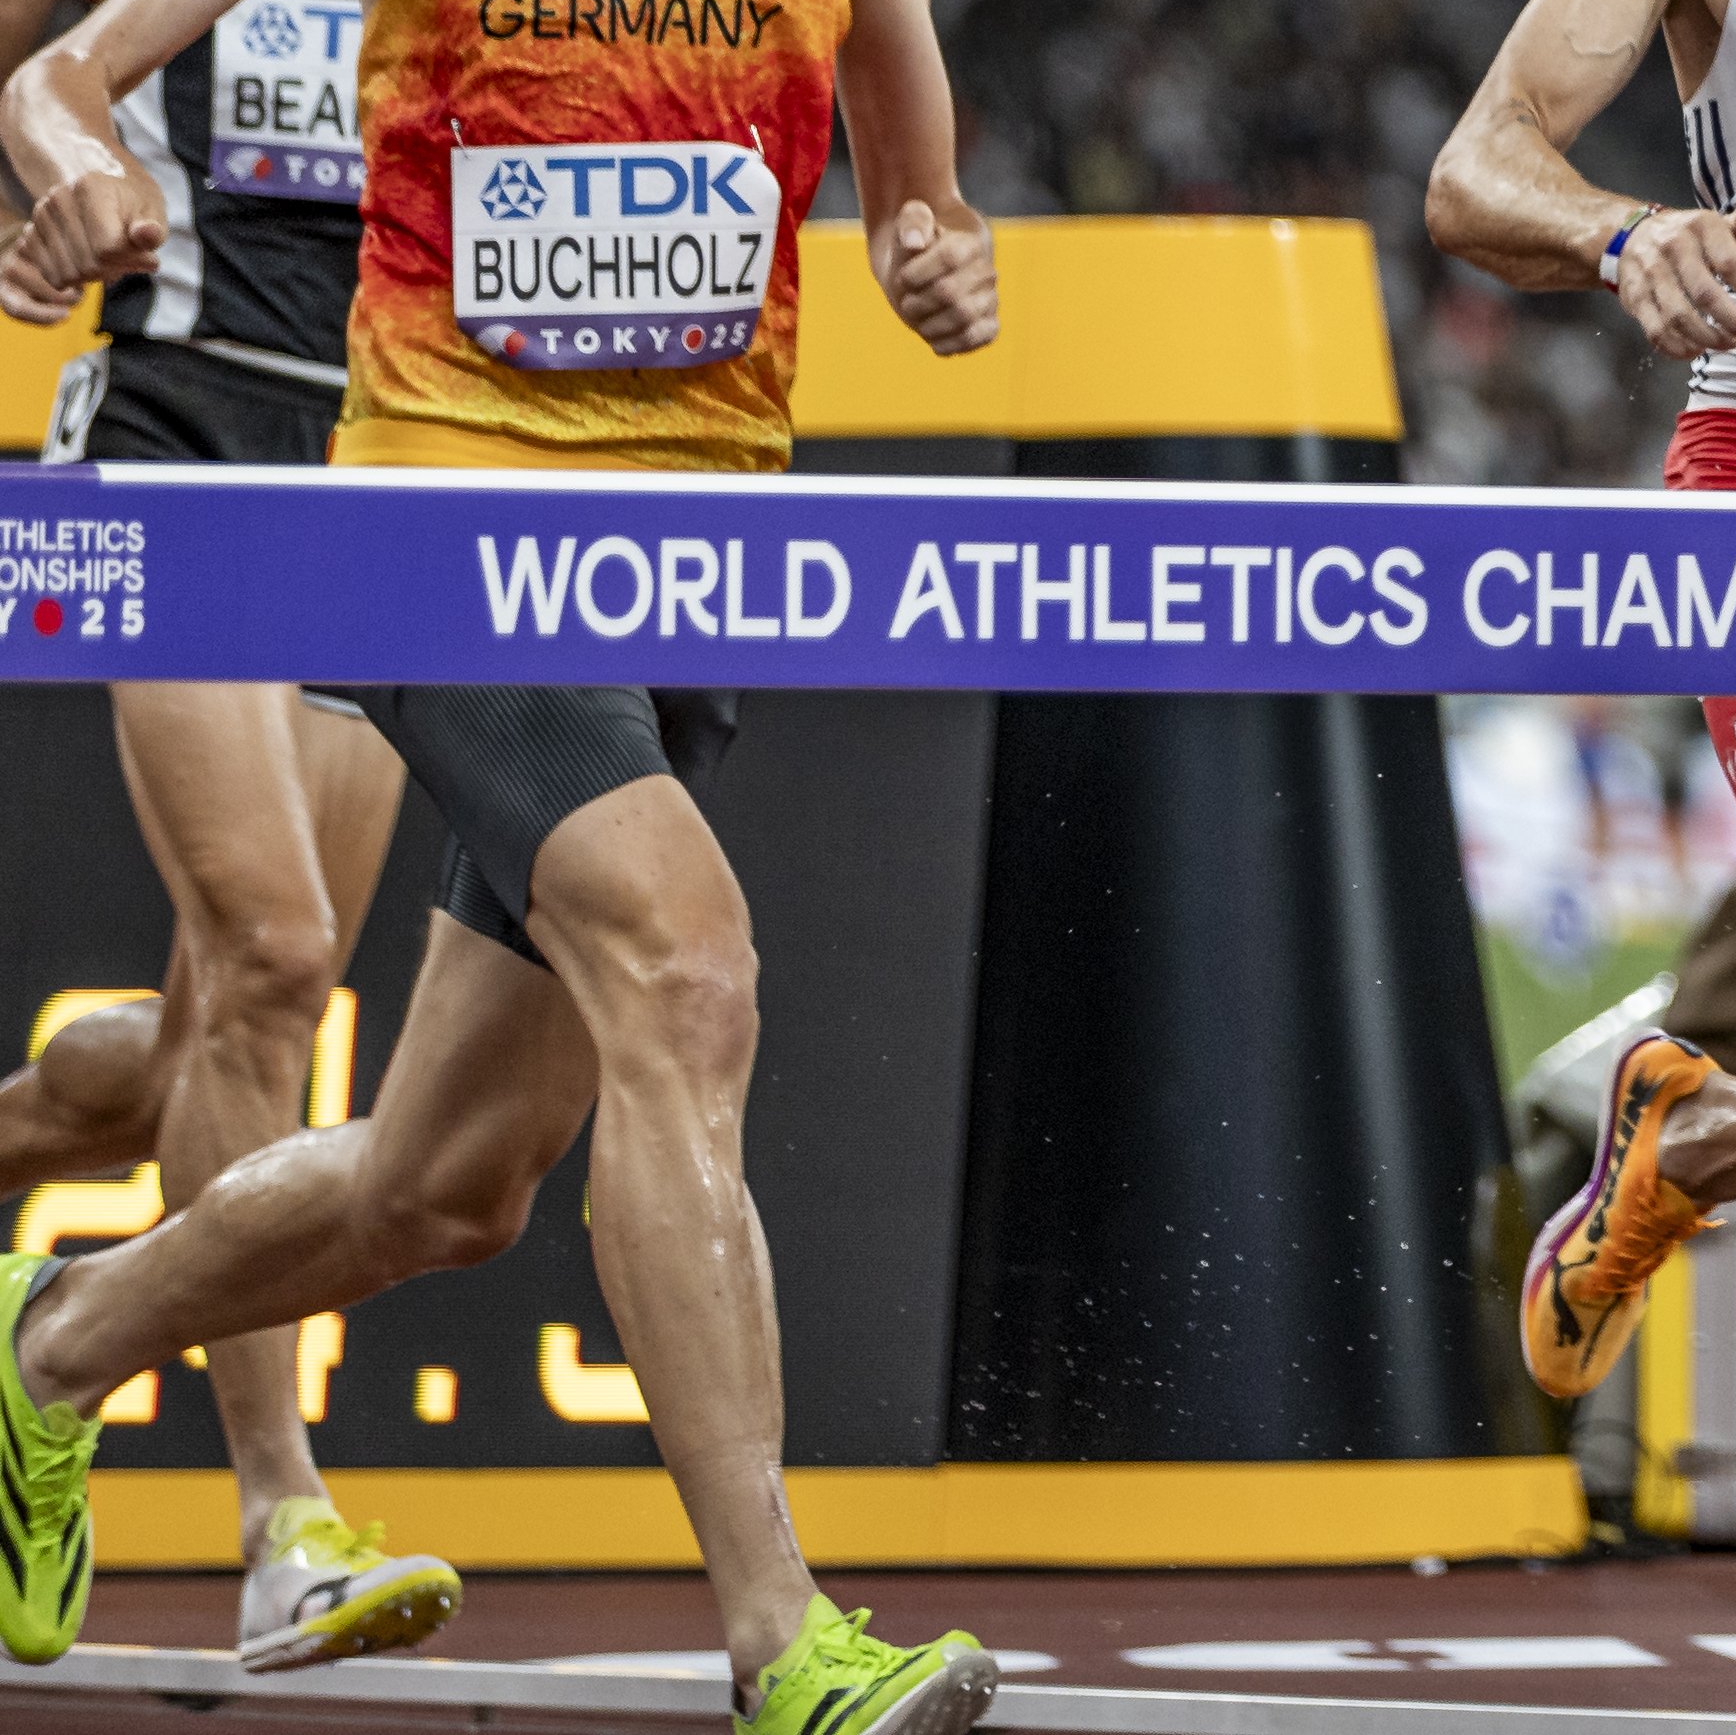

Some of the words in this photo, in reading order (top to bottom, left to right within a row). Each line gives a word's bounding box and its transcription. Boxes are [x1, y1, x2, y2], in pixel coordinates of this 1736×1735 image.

[545, 154, 756, 217] TDK
[473, 232, 762, 302] BUCHHOLZ
[710, 318, 748, 349] 25
[0, 518, 146, 555] THLETICS
[0, 557, 146, 594] ONSHIPS
[476, 535, 853, 638] WORLD
[887, 541, 1431, 646] ATHLETICS
